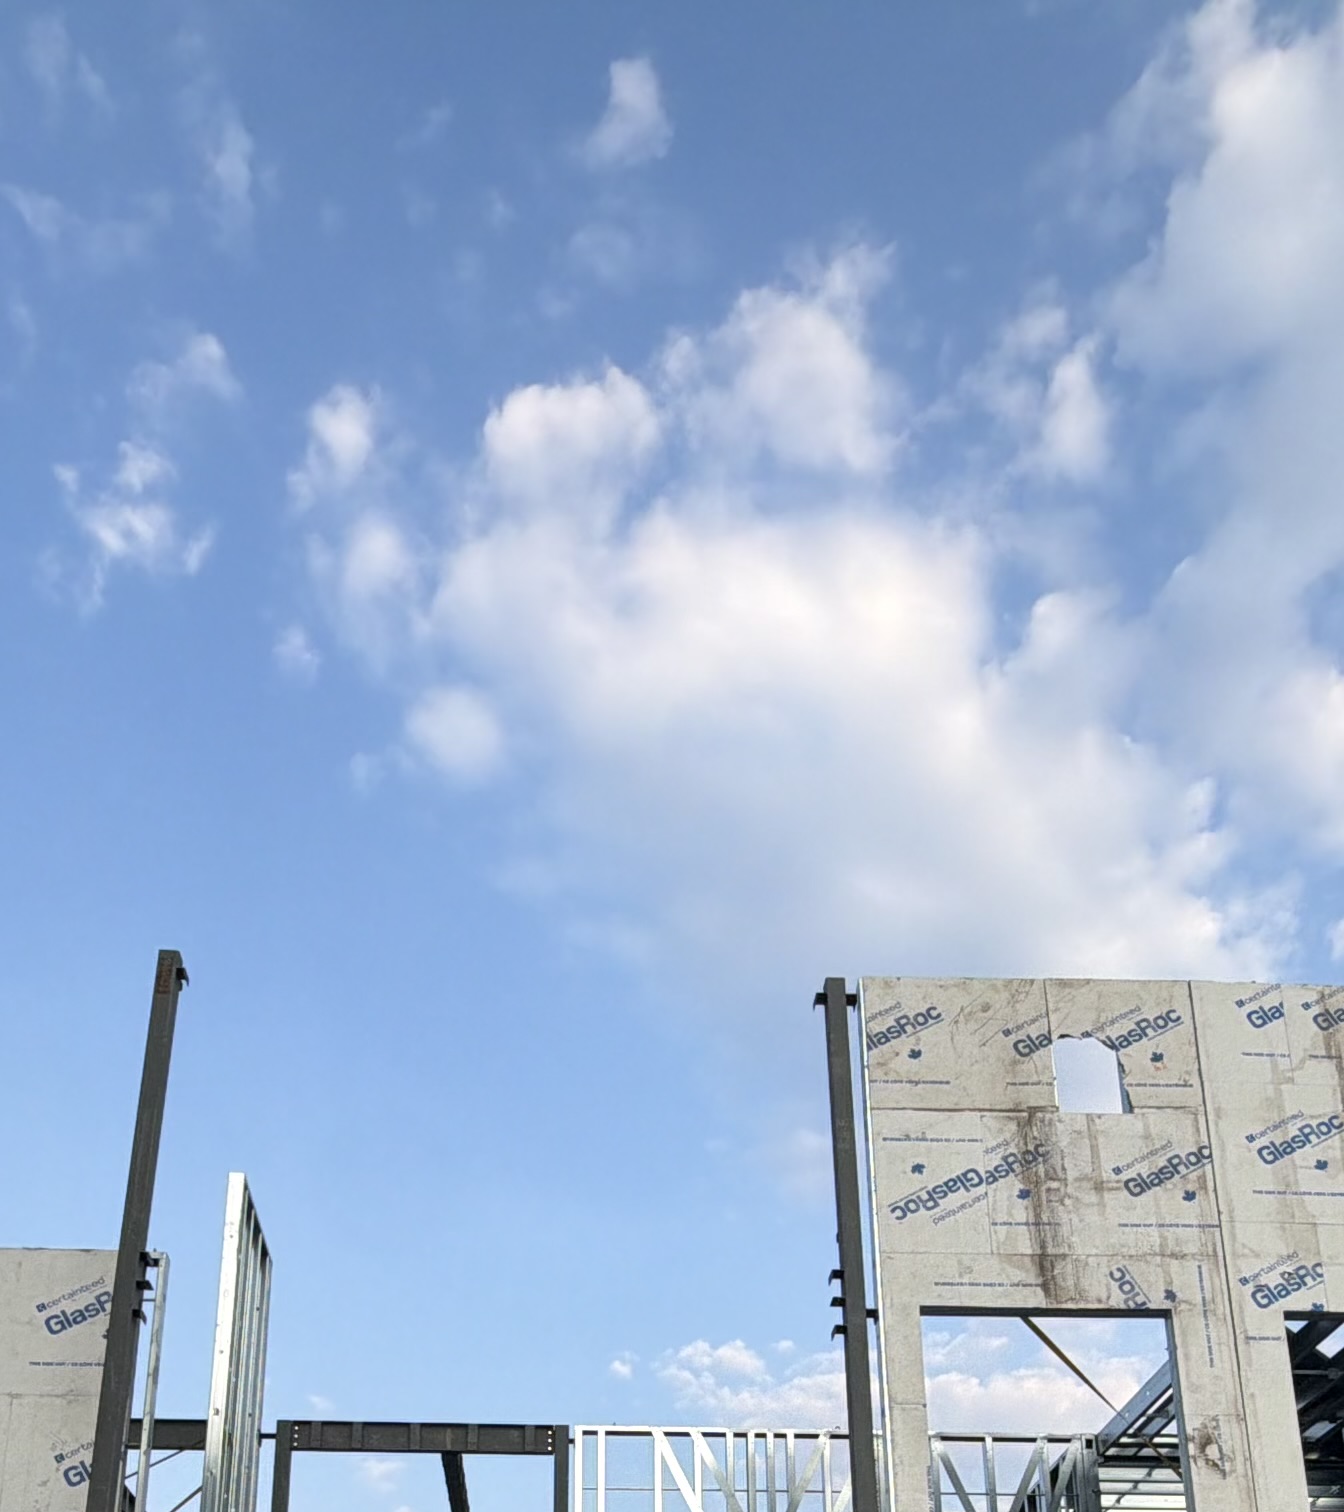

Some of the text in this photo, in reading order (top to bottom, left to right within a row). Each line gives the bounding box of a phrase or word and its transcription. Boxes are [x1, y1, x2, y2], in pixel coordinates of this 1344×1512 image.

[1110, 1009, 1182, 1051] lasRoc
[986, 1142, 1050, 1187] asRoc
[1256, 1114, 1344, 1166] GlasRoc
[890, 1168, 985, 1221] GlasRoc
[1123, 1144, 1212, 1199] GlasRoc
